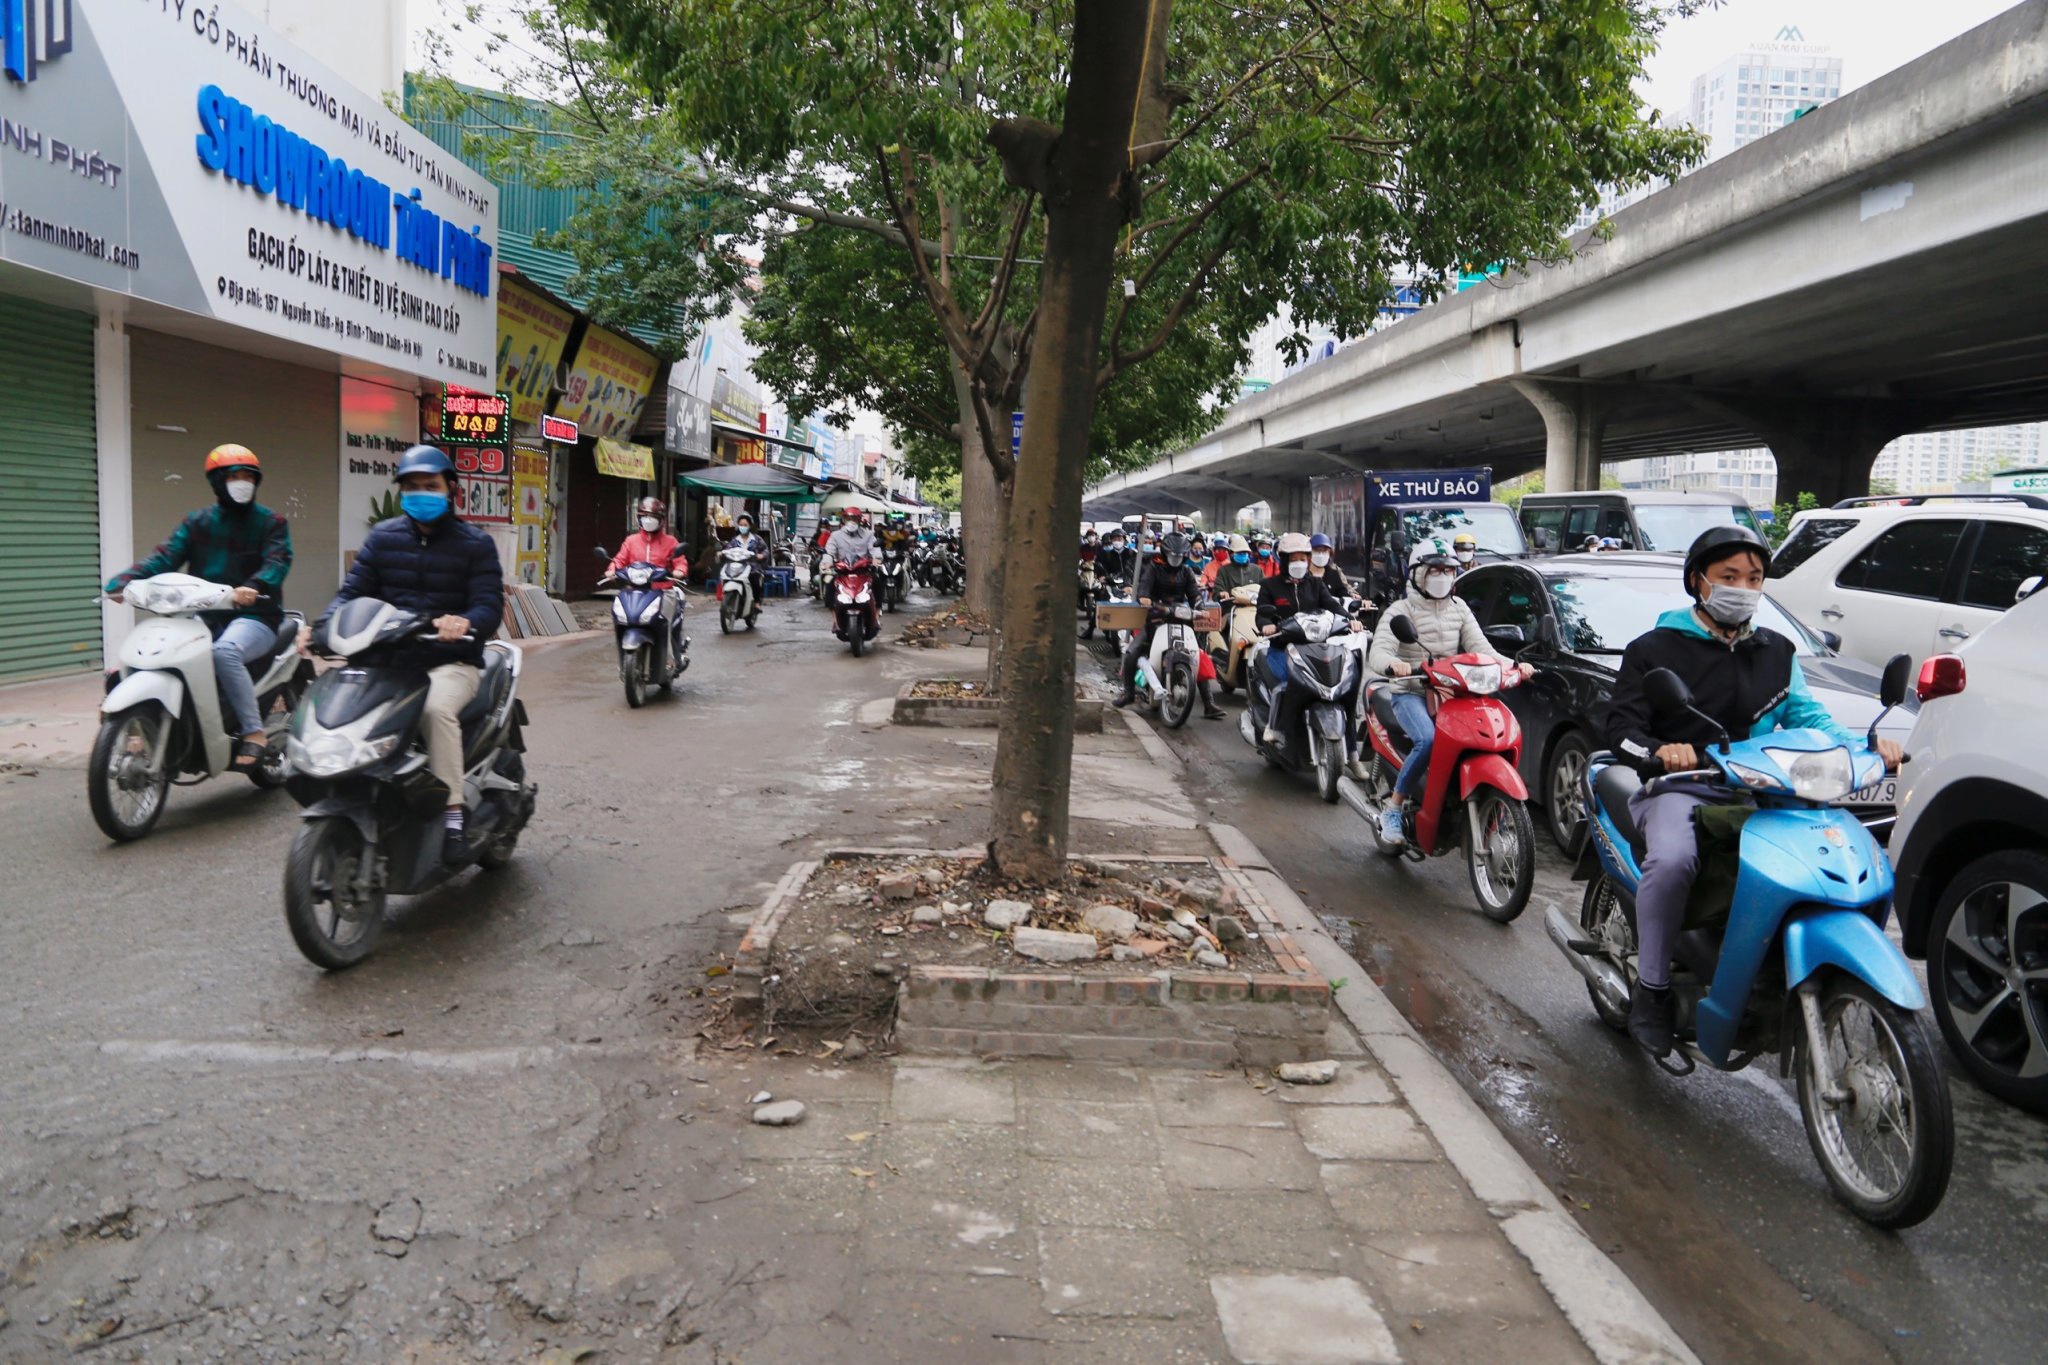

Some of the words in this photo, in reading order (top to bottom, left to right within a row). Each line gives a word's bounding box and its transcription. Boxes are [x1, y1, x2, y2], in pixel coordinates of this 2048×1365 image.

[193, 4, 220, 44] CỔ
[226, 28, 272, 79] PHẦN
[277, 62, 337, 119] THƯƠNG
[341, 104, 363, 138] MẠI
[367, 120, 381, 149] VÀ
[384, 130, 407, 163] ĐẦU
[409, 150, 424, 173] TƯ
[425, 160, 443, 187] TÂN
[445, 174, 466, 200] MINH
[468, 188, 489, 216] PHÁT
[48, 136, 122, 189] PHÁT
[195, 84, 391, 250] SHOWROOM
[393, 187, 440, 274] TÂN
[442, 224, 493, 298] PHÁT
[248, 227, 285, 271] GẠCH
[288, 234, 305, 277] ỐP
[308, 250, 330, 287] LÁT
[331, 263, 340, 291] &
[341, 264, 371, 302] THIẾT
[374, 279, 384, 313] BỊ
[386, 281, 399, 319] VỆ
[400, 291, 423, 322] SINH
[425, 300, 441, 330] CAO
[444, 302, 460, 335] CẤP
[264, 293, 278, 313] 157
[439, 447, 505, 473] 59
[1379, 482, 1400, 497] XE
[1404, 478, 1439, 496] THƯ
[1443, 478, 1480, 495] BÁO
